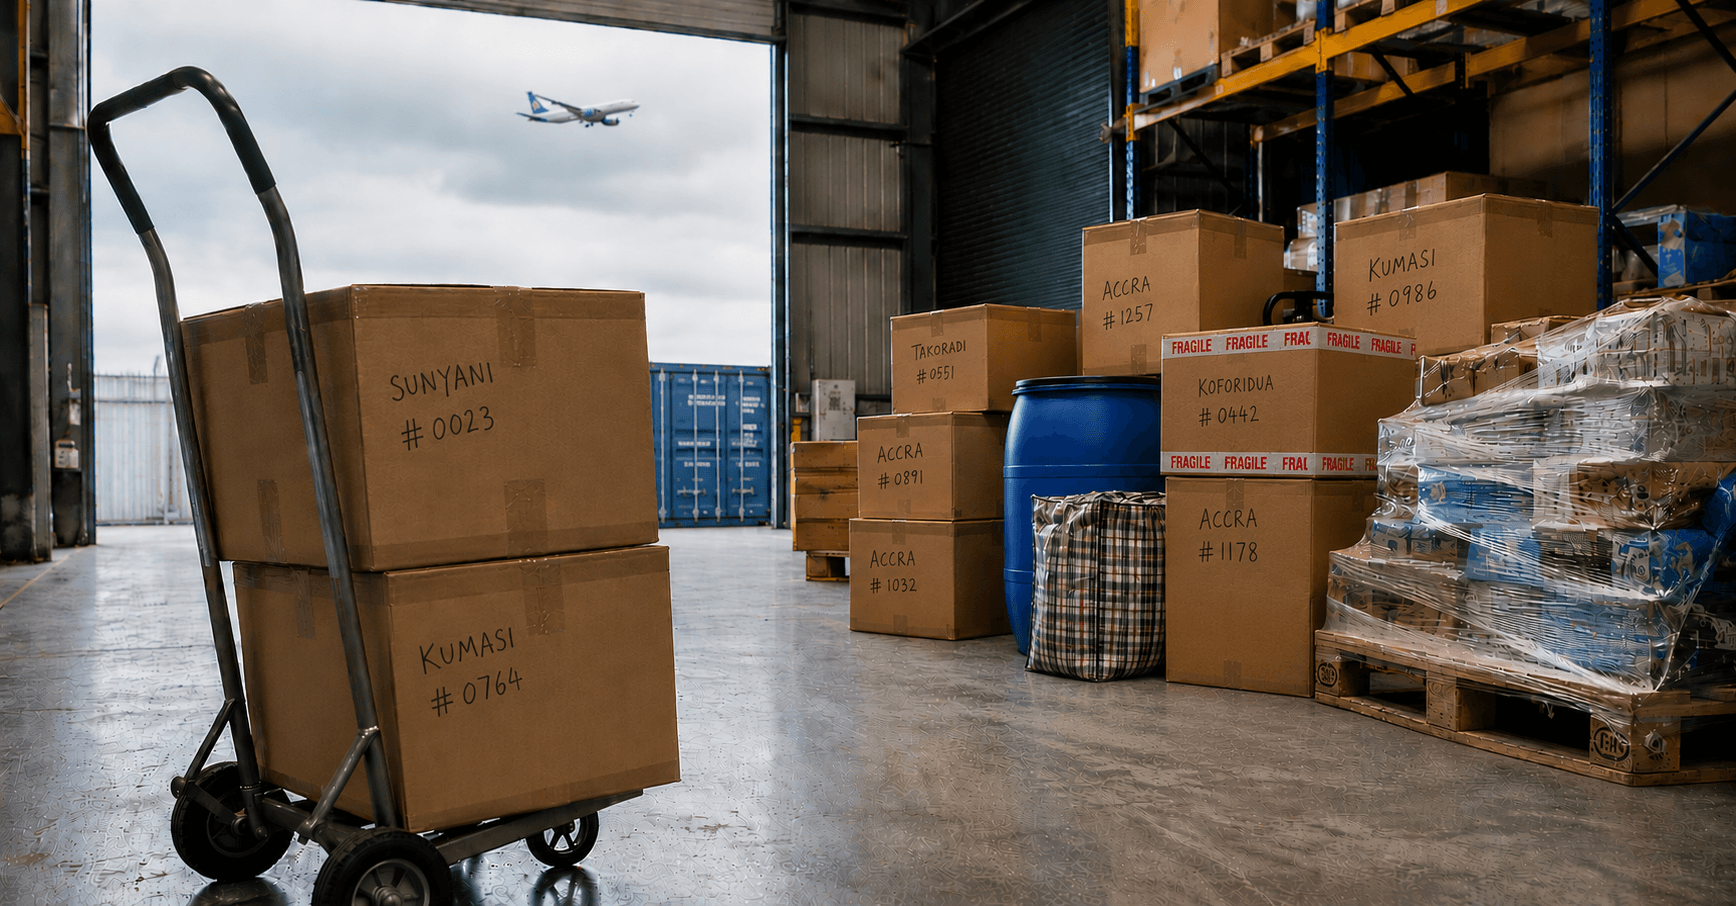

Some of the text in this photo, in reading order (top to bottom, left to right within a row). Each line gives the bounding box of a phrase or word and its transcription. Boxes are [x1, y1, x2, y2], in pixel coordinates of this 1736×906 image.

[1368, 248, 1435, 283] KUMASI
[1102, 275, 1151, 301] ACCRA
[910, 339, 966, 361] TAKORADI
[1172, 339, 1212, 354] FRAGILE
[1226, 334, 1268, 350] FRAGILE
[1327, 332, 1360, 349] FRAGILE
[1372, 336, 1403, 354] FRAGILE
[390, 362, 494, 402] SUNYANI
[1198, 374, 1274, 398] KOFORIDUA
[877, 442, 923, 464] ACCRA
[1171, 456, 1210, 469] FRAGILE
[1225, 456, 1267, 470] FRAGILE
[1322, 457, 1354, 471] FRAGILE
[1198, 507, 1258, 530] ACCRA
[869, 549, 916, 569] ACCRA
[419, 627, 514, 675] KUMASI
